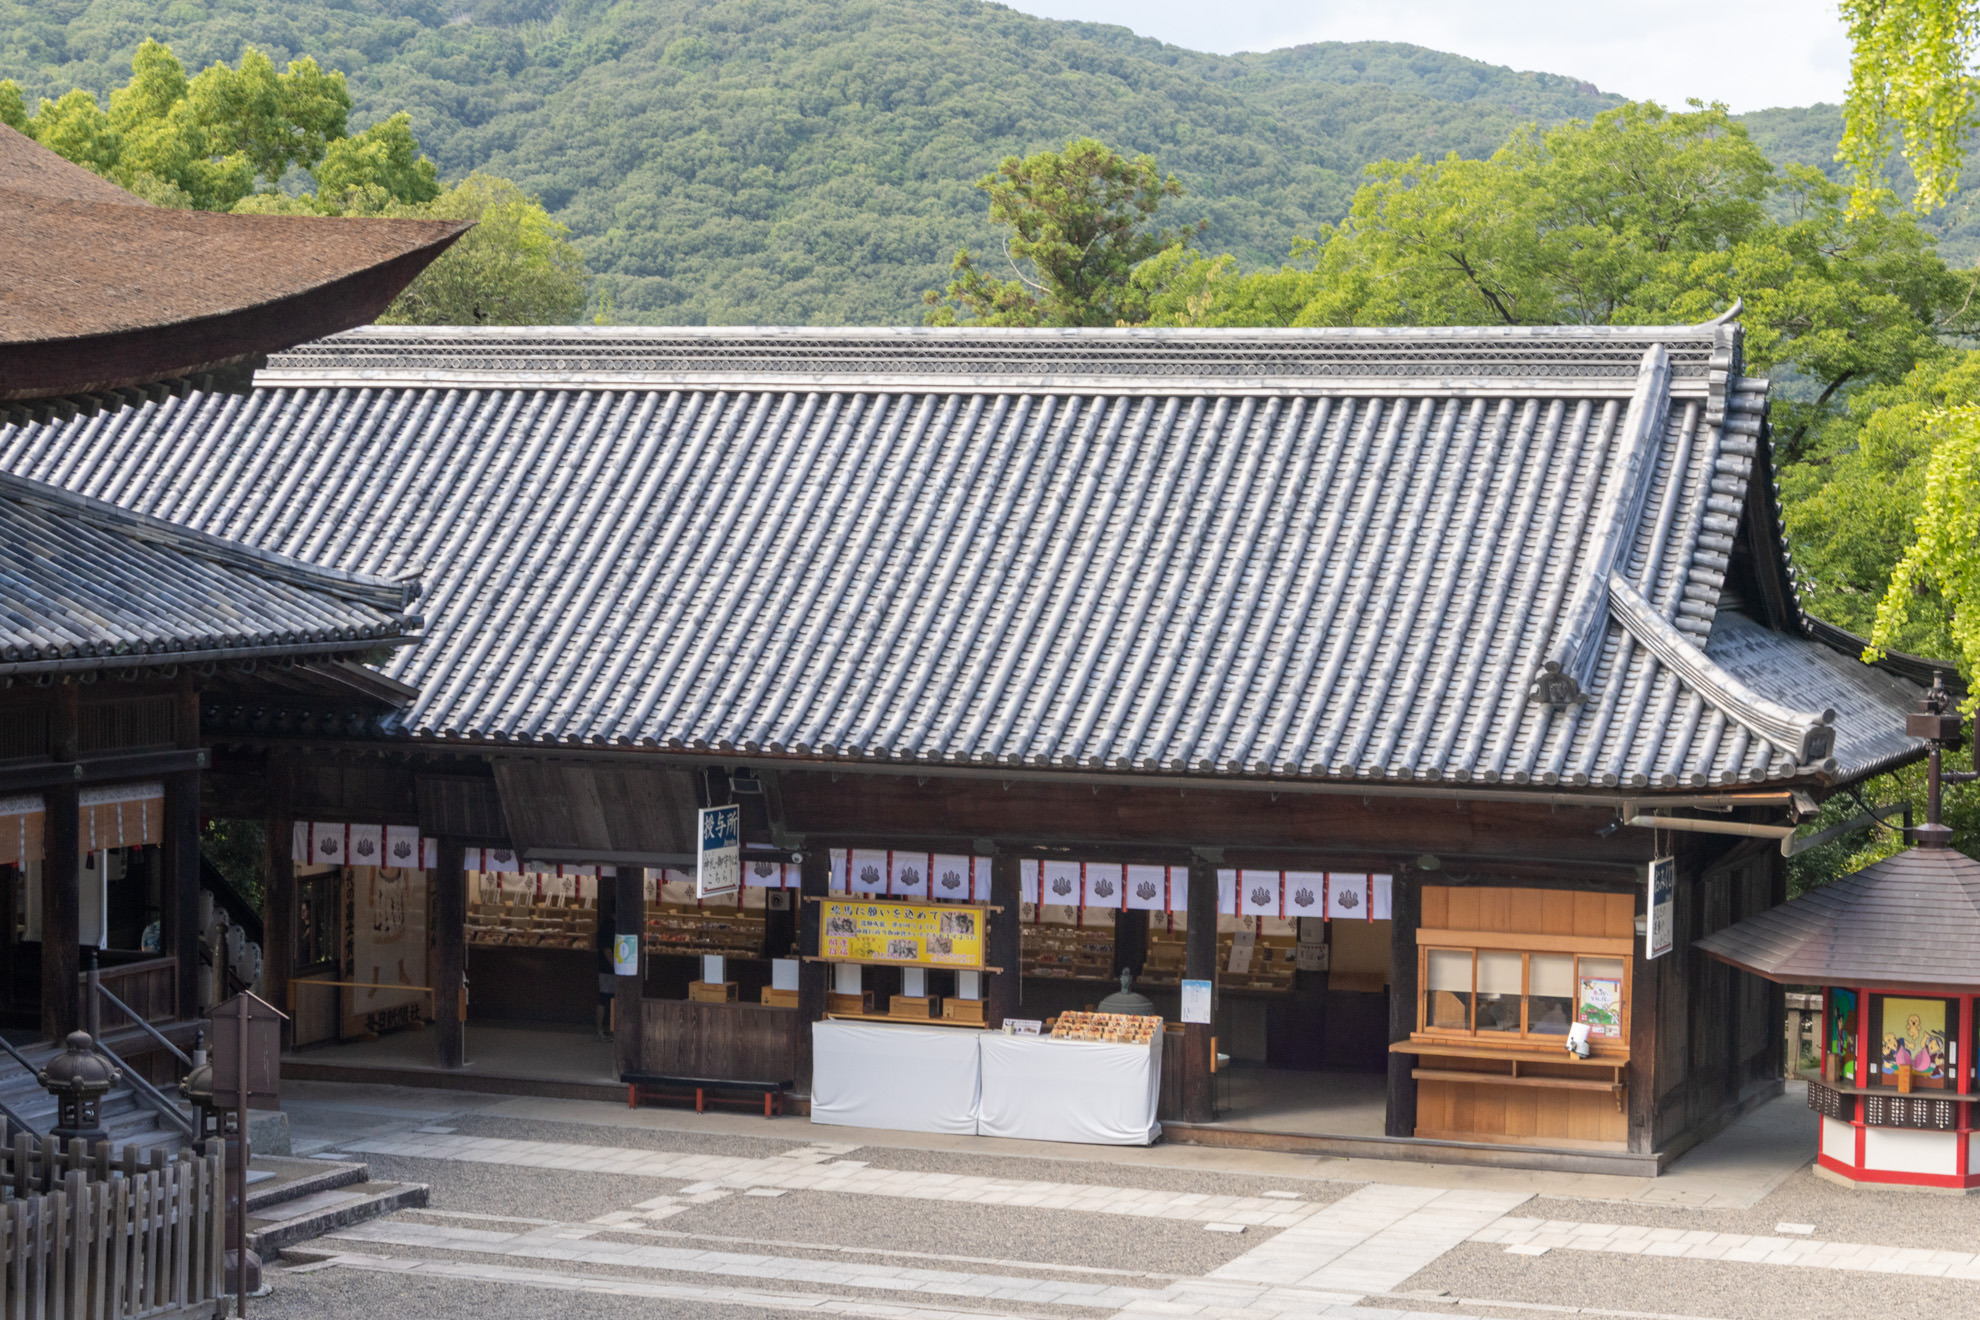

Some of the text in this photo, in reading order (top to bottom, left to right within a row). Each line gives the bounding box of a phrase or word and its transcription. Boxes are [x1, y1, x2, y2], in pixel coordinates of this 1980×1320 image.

[704, 810, 738, 840] 授与所
[830, 904, 939, 920] 絵馬に願いを込めて
